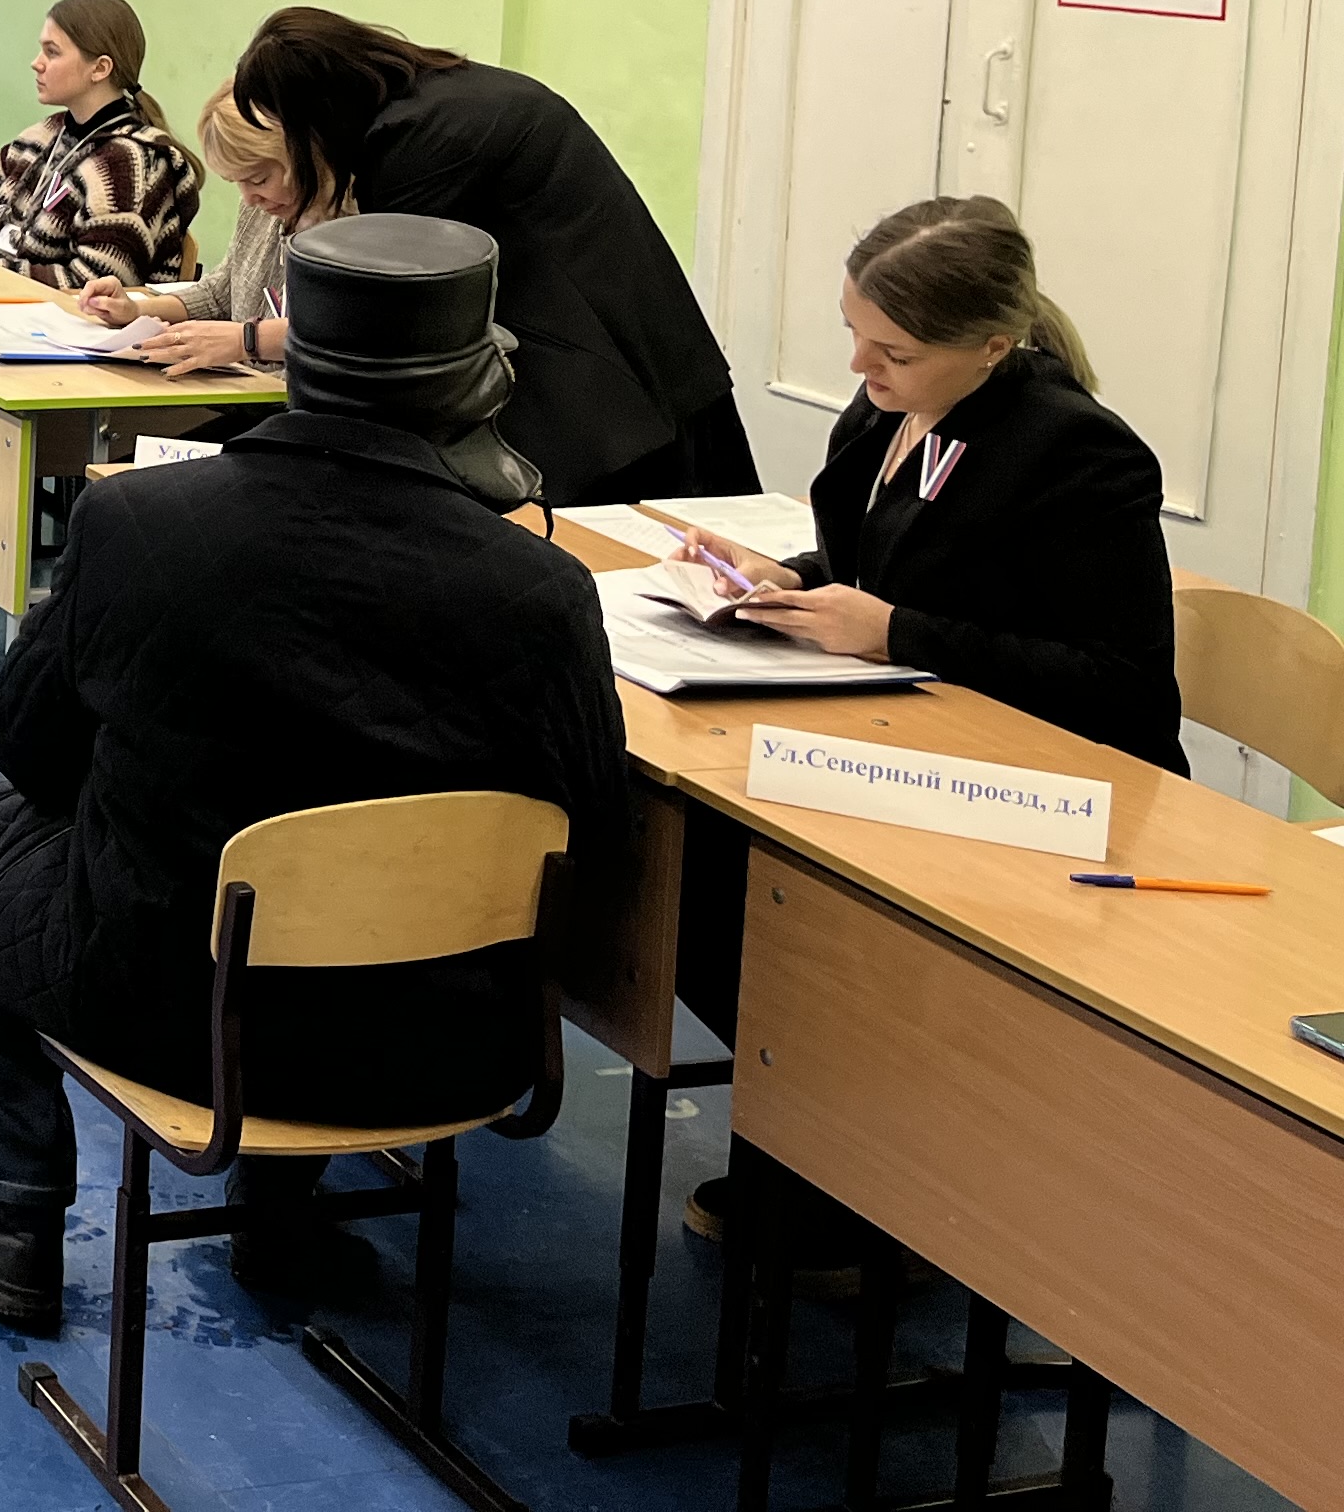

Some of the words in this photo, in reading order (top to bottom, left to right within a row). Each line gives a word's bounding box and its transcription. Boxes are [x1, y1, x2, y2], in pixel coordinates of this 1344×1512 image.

[761, 739, 941, 790] Ул.Северный
[950, 778, 1047, 813] проезд,
[1054, 797, 1094, 818] д.4
